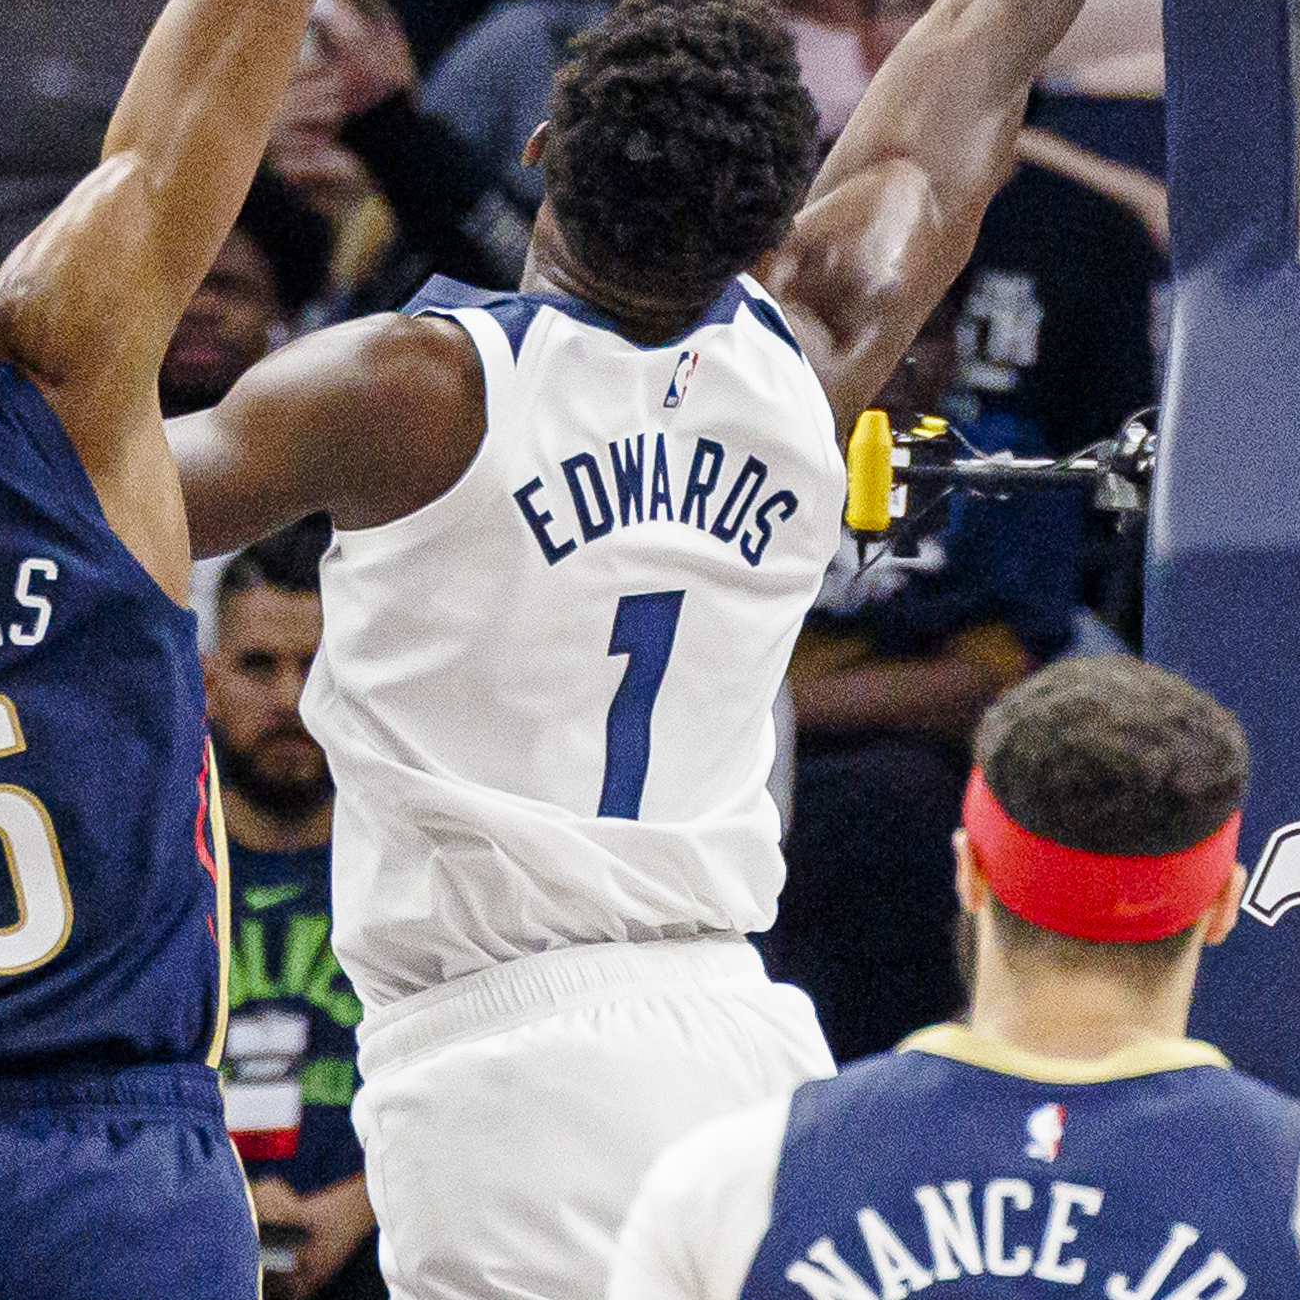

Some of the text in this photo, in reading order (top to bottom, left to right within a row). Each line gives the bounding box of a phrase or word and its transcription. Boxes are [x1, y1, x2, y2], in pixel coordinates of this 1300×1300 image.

[513, 432, 798, 567] EDWARDS
[598, 590, 687, 821] 1
[785, 1178, 1104, 1300] NANCE
